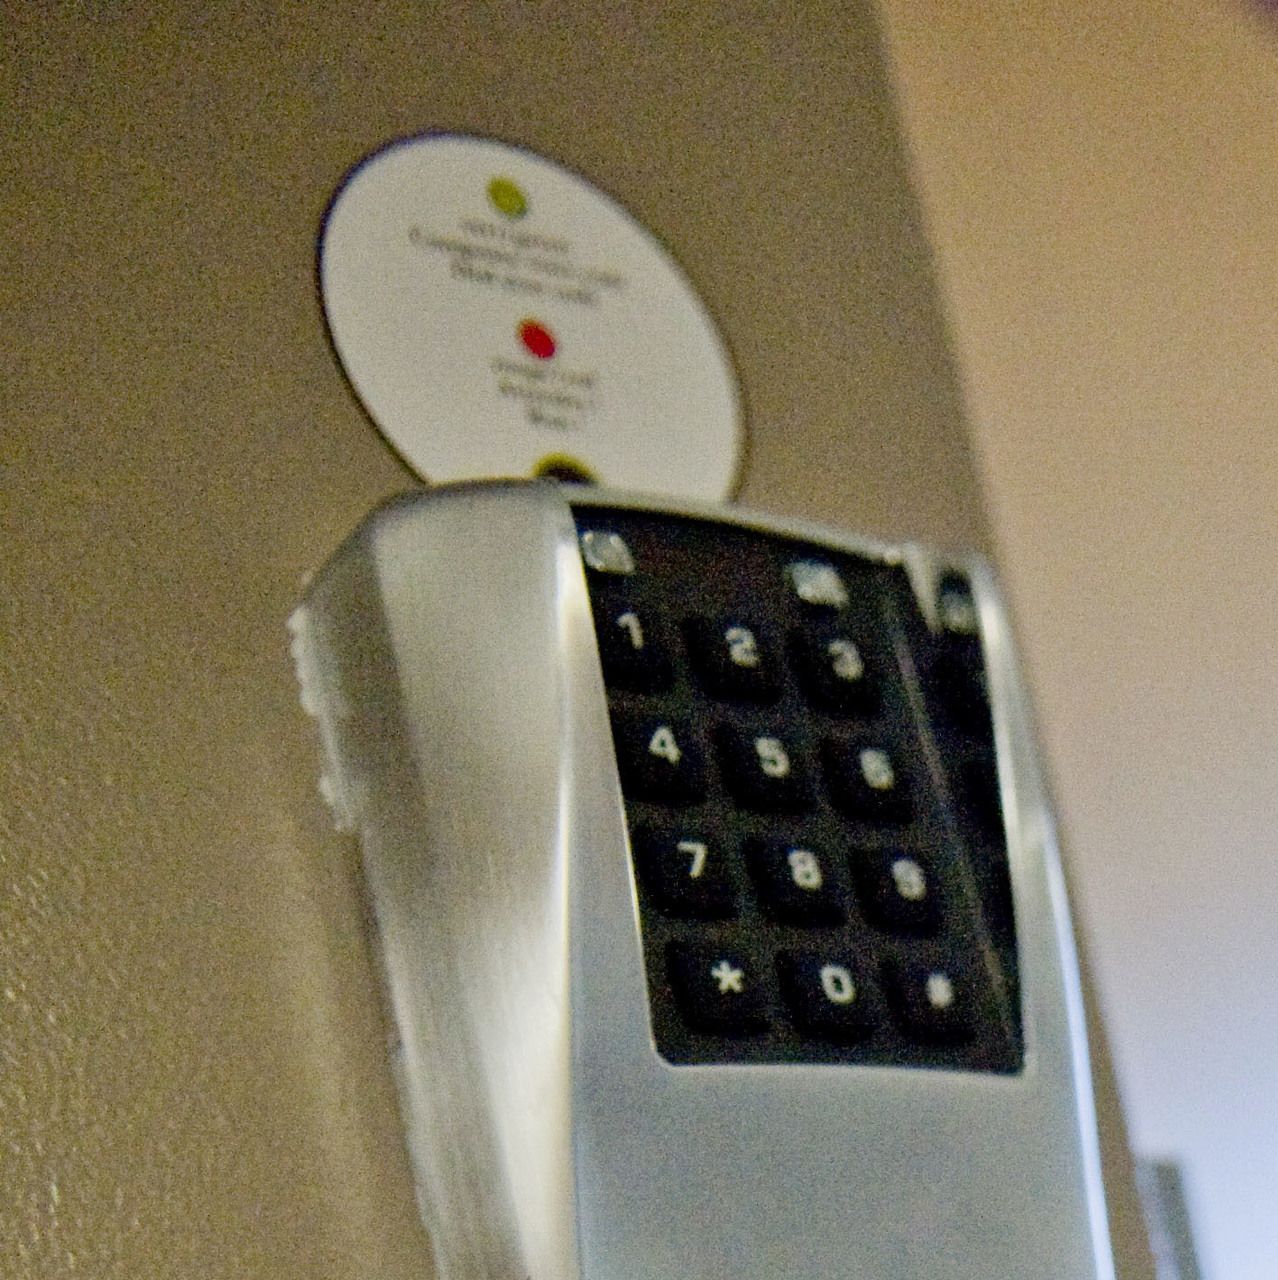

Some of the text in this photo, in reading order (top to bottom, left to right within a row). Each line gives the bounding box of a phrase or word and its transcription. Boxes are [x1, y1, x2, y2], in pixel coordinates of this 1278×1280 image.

[617, 611, 644, 649] 1
[725, 627, 760, 668] 2
[648, 726, 682, 765] 4
[755, 736, 790, 779] 5
[677, 840, 709, 879] 7
[787, 848, 824, 891] 8
